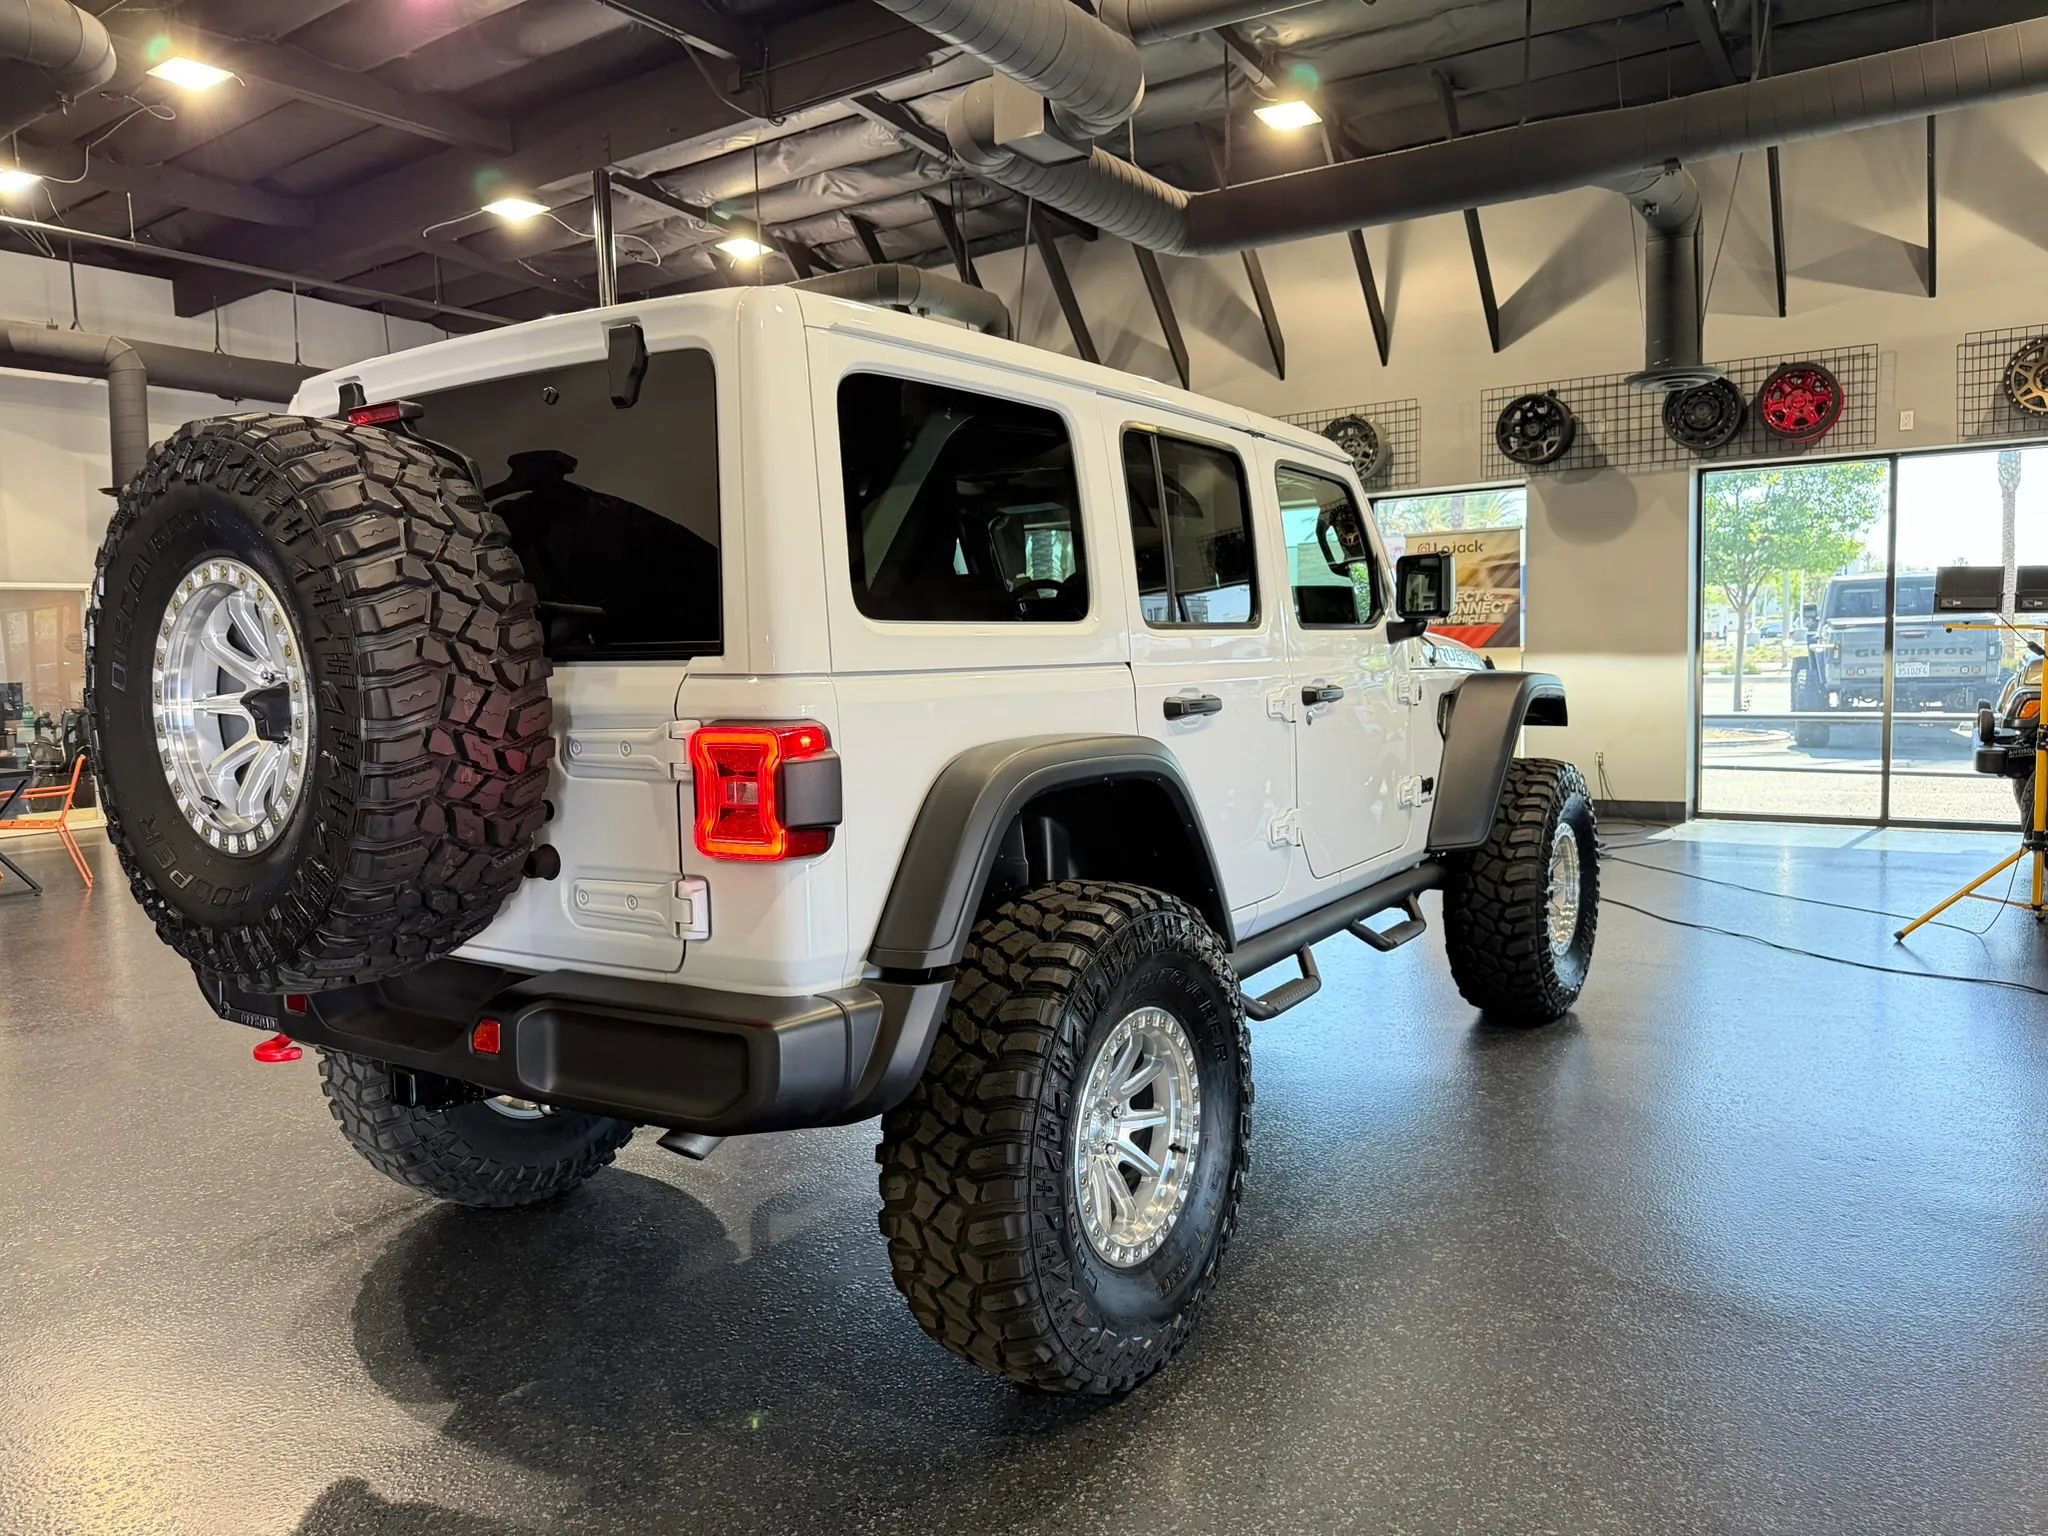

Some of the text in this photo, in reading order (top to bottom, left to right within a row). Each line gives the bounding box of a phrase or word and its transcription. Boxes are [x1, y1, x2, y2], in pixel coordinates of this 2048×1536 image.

[1456, 590, 1483, 602] ECT
[1453, 600, 1514, 614] ONNECT
[1445, 614, 1486, 625] VEHICLE
[1855, 647, 1975, 658] GLDIATOR
